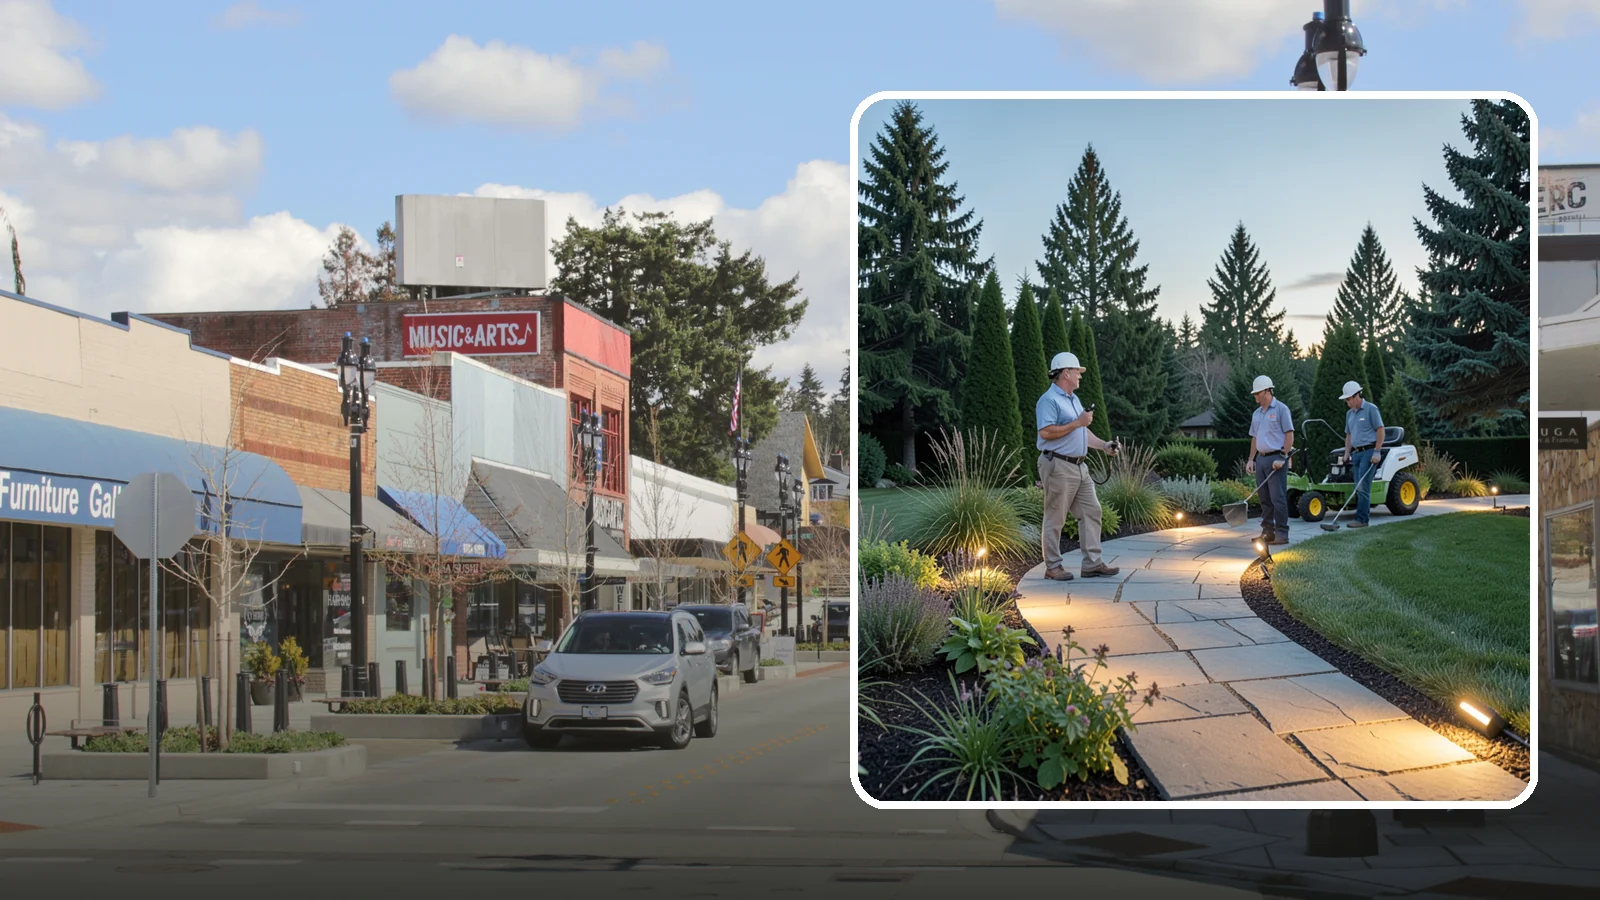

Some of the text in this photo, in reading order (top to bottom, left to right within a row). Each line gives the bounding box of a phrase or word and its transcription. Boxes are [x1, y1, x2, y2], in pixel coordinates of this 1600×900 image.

[409, 322, 519, 349] MUSIC&ARTS
[1540, 427, 1577, 437] UGA
[0, 472, 121, 519] Furniture Gal
